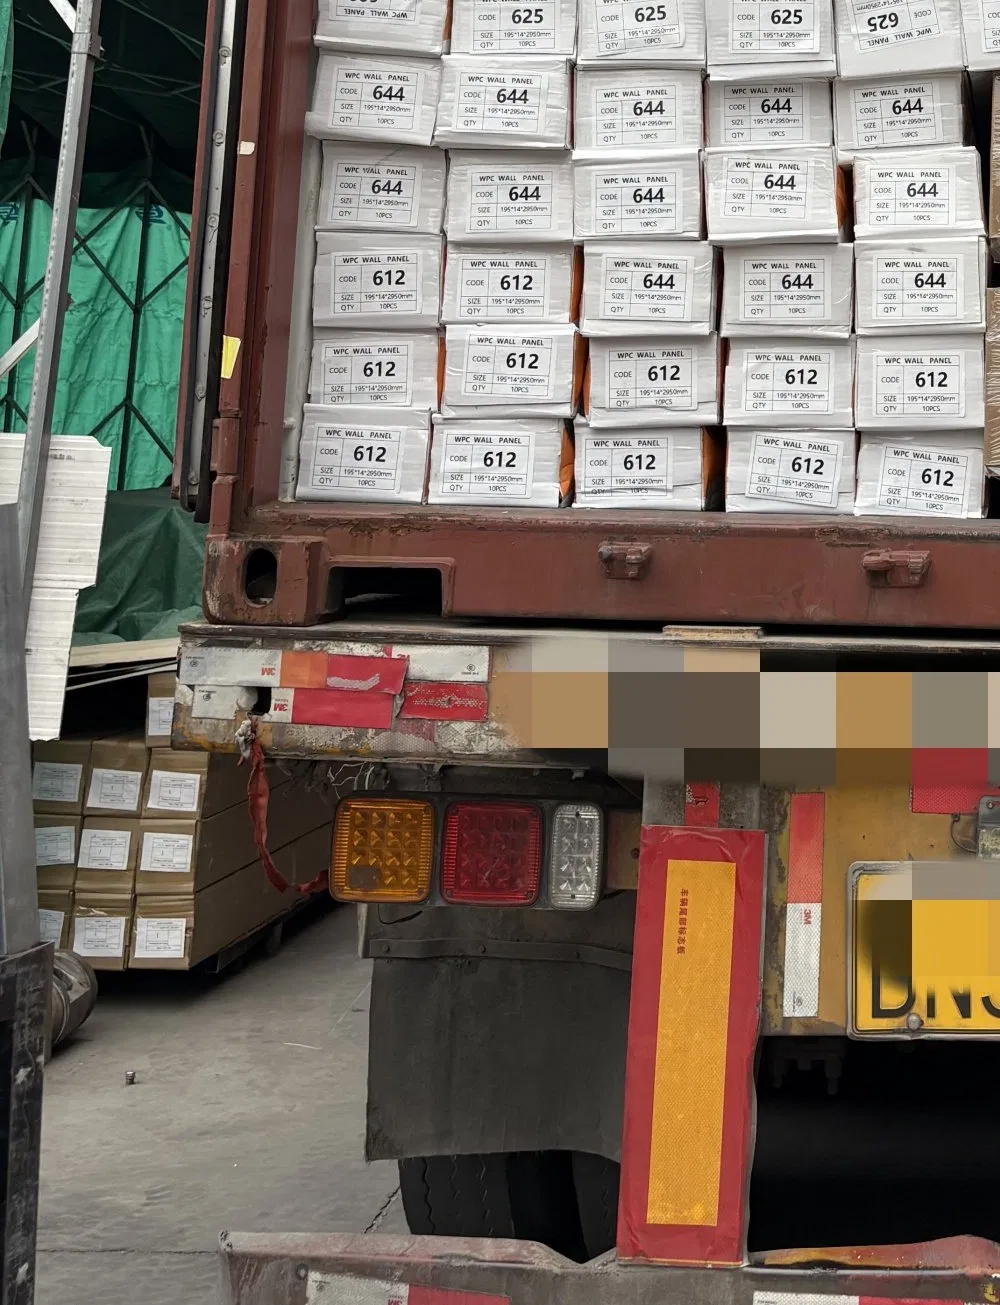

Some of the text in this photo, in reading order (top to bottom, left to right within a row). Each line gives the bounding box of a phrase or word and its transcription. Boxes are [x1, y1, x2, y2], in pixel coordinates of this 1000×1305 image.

[344, 8, 365, 16] PANEL
[391, 11, 408, 19] WPC
[867, 12, 898, 32] 625
[892, 98, 924, 115] 644
[603, 177, 619, 185] WPC
[600, 188, 665, 203] CODE 644
[602, 220, 658, 230] QTY 10PCS
[914, 273, 946, 288] 644
[473, 436, 493, 444] WALL
[498, 437, 522, 445] PANEL
[483, 451, 516, 467] 612
[922, 468, 954, 487] 612
[449, 484, 463, 492] QTY
[261, 667, 277, 676] 3M
[273, 702, 289, 712] 3M
[803, 908, 812, 925] 3M
